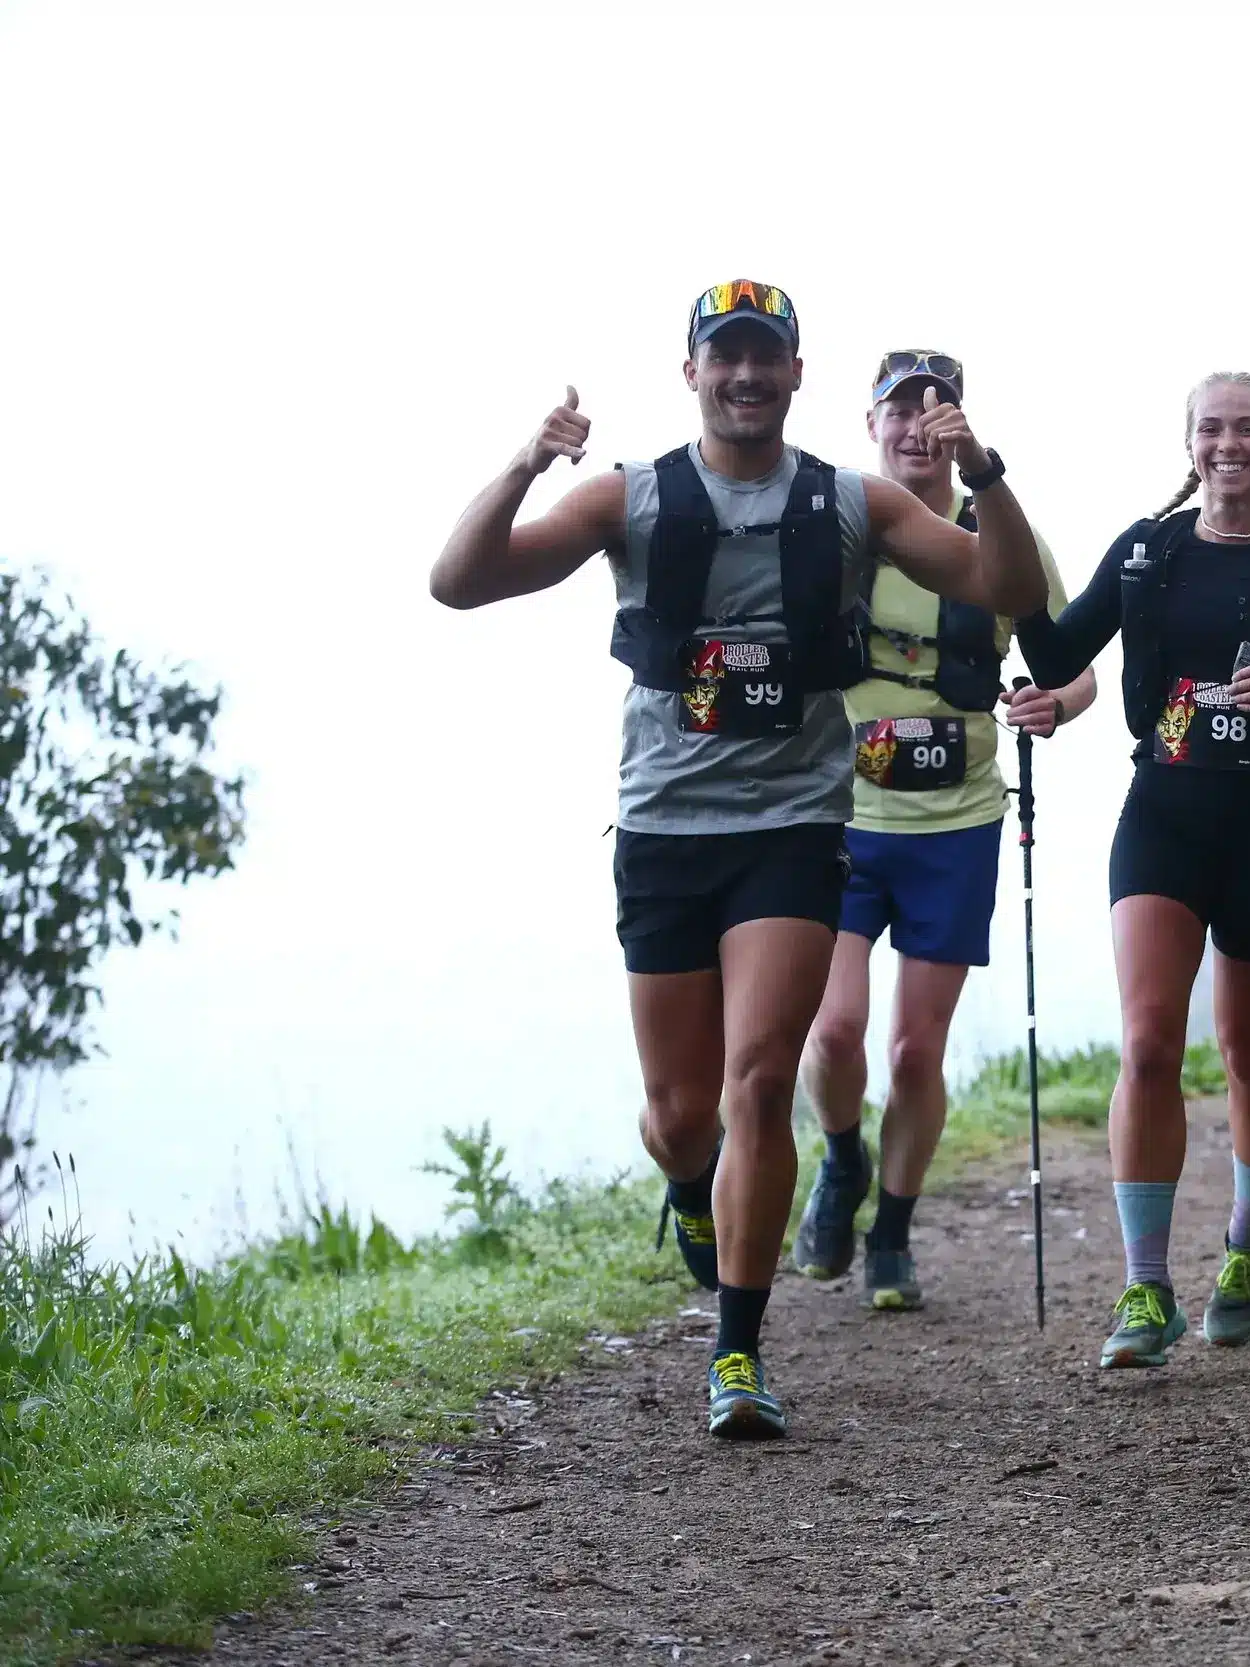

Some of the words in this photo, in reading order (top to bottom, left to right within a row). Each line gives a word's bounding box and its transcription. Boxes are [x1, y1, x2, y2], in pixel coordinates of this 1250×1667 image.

[724, 652, 770, 666] COASTER
[727, 644, 767, 657] ROLLER
[745, 683, 783, 706] 99
[1211, 714, 1247, 742] 98
[913, 745, 947, 769] 90
